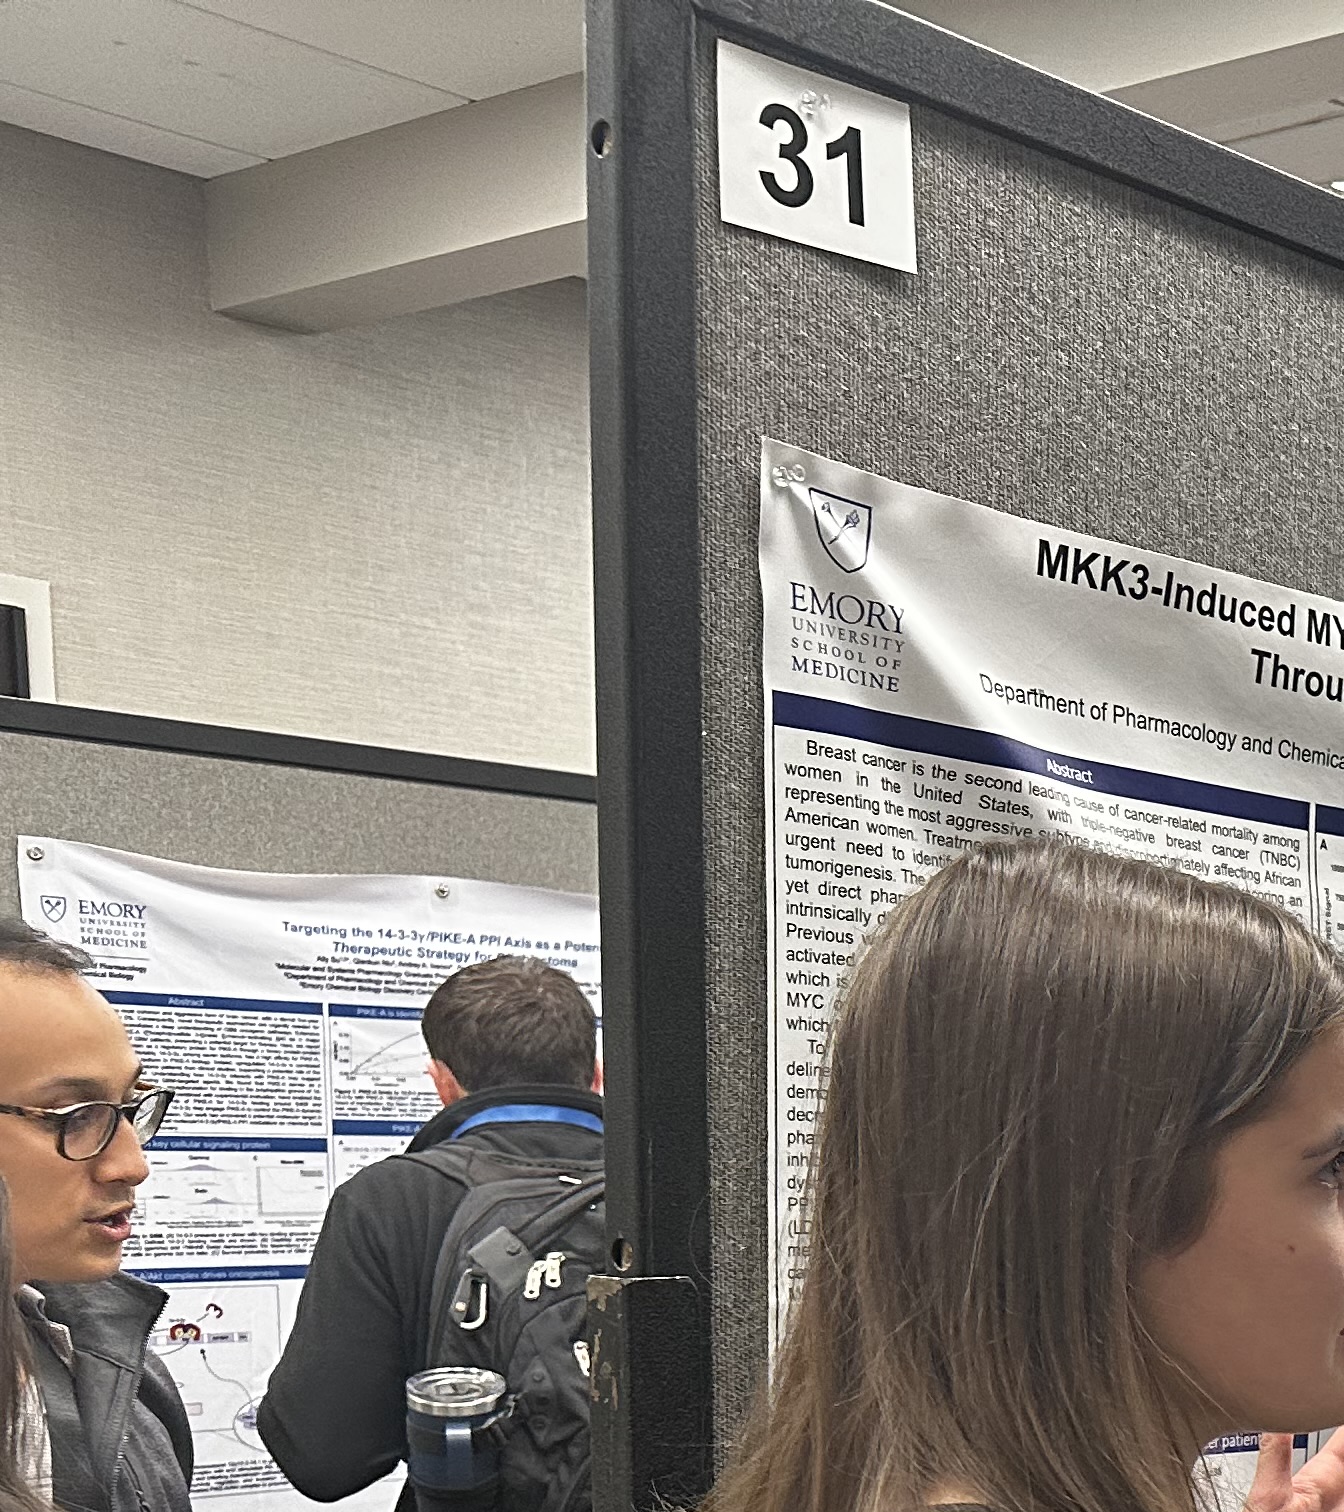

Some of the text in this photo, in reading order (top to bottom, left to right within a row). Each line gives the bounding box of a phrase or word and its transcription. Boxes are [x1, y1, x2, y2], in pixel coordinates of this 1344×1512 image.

[758, 103, 865, 227] 31
[1037, 538, 1295, 638] MKK3-Induced
[790, 581, 904, 634] EMORY
[792, 617, 905, 653] UNIVERSITY
[791, 637, 901, 670] SCHOOL OF
[791, 656, 899, 692] MEDICINE
[980, 673, 1085, 718] Department
[1090, 702, 1107, 721] of
[1113, 705, 1236, 750] Pharmacology
[1241, 738, 1272, 755] and
[1047, 758, 1093, 784] Abstract
[807, 740, 856, 762] Breast
[863, 753, 907, 772] cancer
[913, 761, 924, 776] is
[932, 764, 957, 781] the
[964, 771, 1022, 793] second
[1109, 805, 1120, 817] of
[1125, 810, 1206, 833] cancer-related
[1212, 824, 1258, 843] mortality
[1263, 834, 1300, 852] among
[785, 763, 1301, 871] women in the United States, with triple-negative breast cancer (TNBC)
[785, 808, 983, 851] American women. Treatme
[785, 787, 879, 815] representing
[885, 801, 903, 816] the
[909, 809, 941, 824] most
[946, 814, 1032, 838] aggressive
[1214, 864, 1260, 884] affecting
[1265, 871, 1301, 888] African
[786, 833, 952, 866] urgent need to identif
[1320, 839, 1328, 850] A
[786, 854, 925, 886] tumorigenesis. The
[786, 879, 861, 900] yet direct
[78, 900, 146, 919] EMORY
[786, 901, 871, 927] intrinsically
[81, 936, 147, 948] MEDICINE
[282, 921, 347, 939] Targeting
[352, 926, 373, 937] the
[480, 936, 501, 947] PPI
[504, 937, 531, 949] Axis
[535, 941, 550, 950] as
[554, 942, 560, 951] a
[565, 940, 600, 953] Poten
[786, 923, 854, 944] Previous
[333, 942, 491, 963] Therapeutic Strategy for
[786, 949, 855, 967] activated
[786, 970, 830, 987] which
[786, 992, 824, 1009] MYC
[786, 1017, 829, 1032] which
